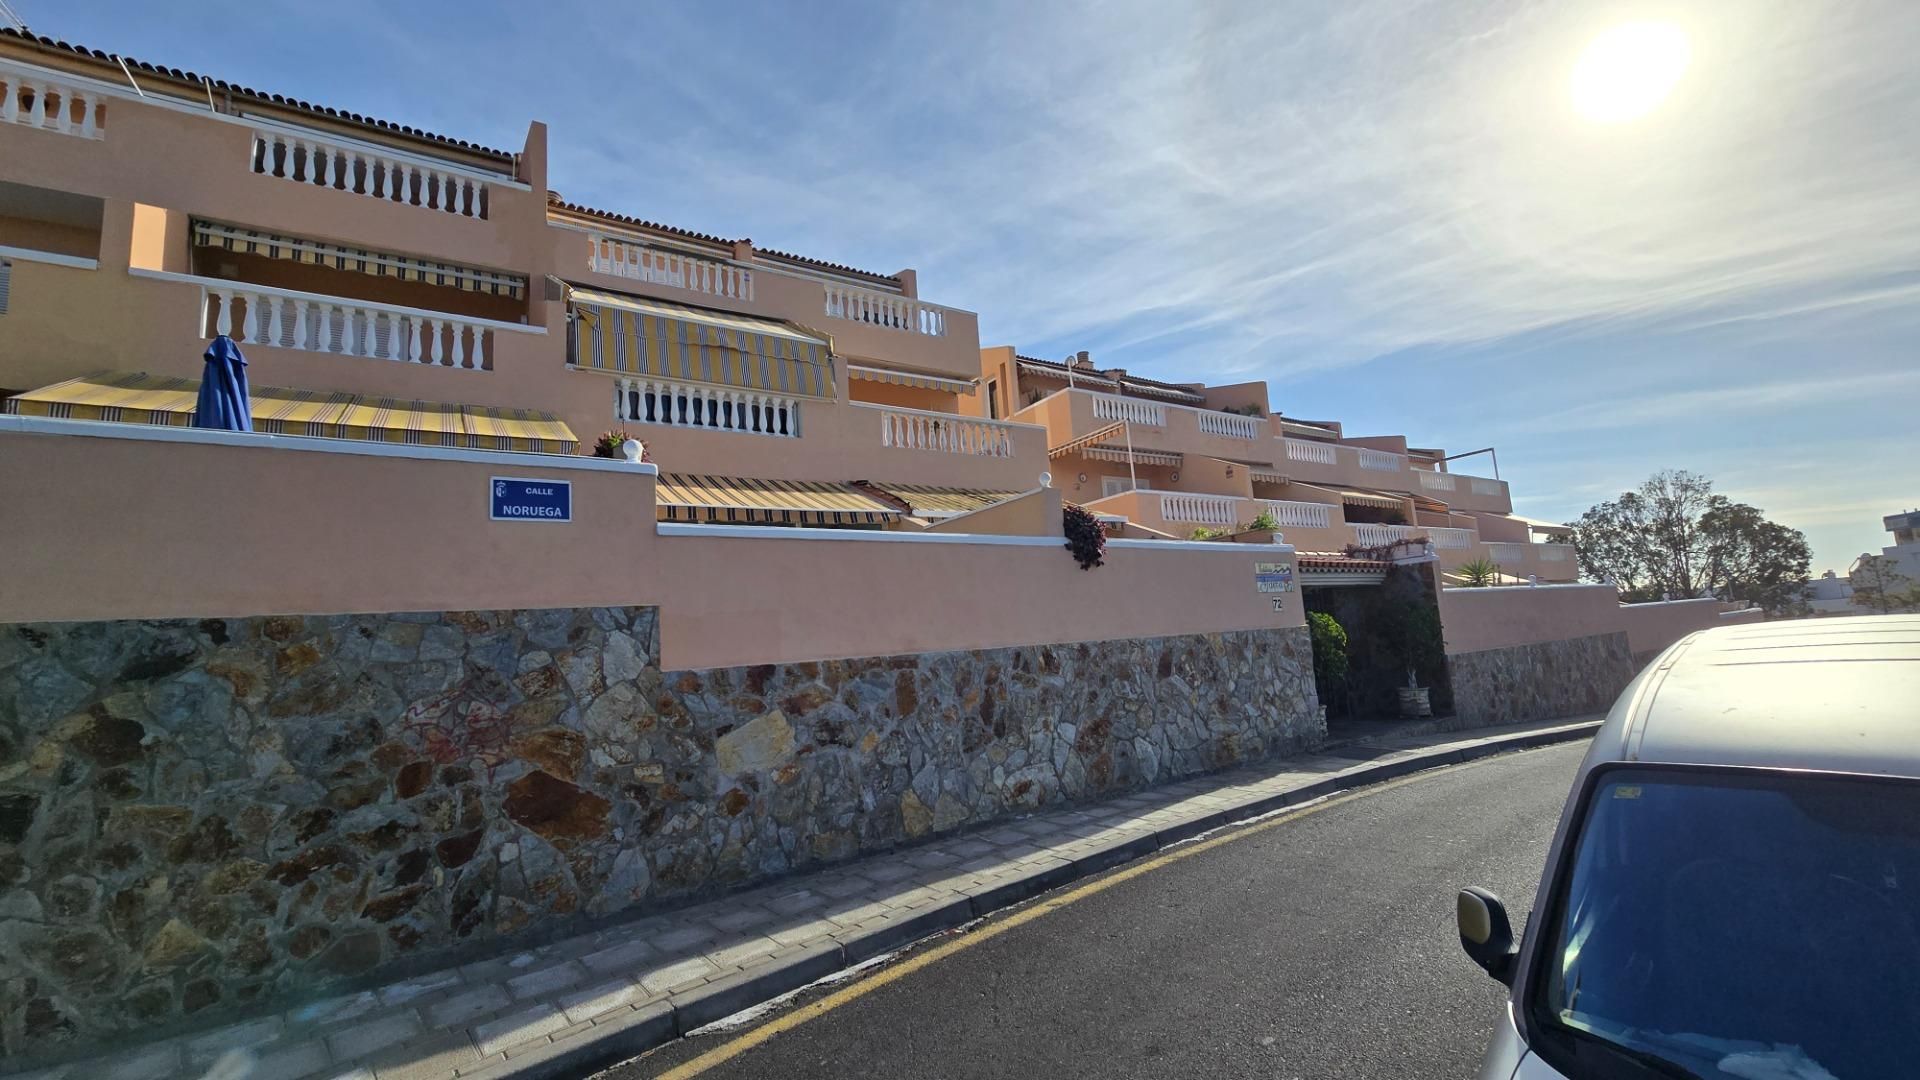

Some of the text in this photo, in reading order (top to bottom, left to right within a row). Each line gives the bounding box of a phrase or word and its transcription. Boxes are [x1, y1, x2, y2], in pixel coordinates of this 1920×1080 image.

[525, 487, 554, 496] CALLE
[503, 505, 562, 517] NORUEGA
[1273, 599, 1282, 608] 72
